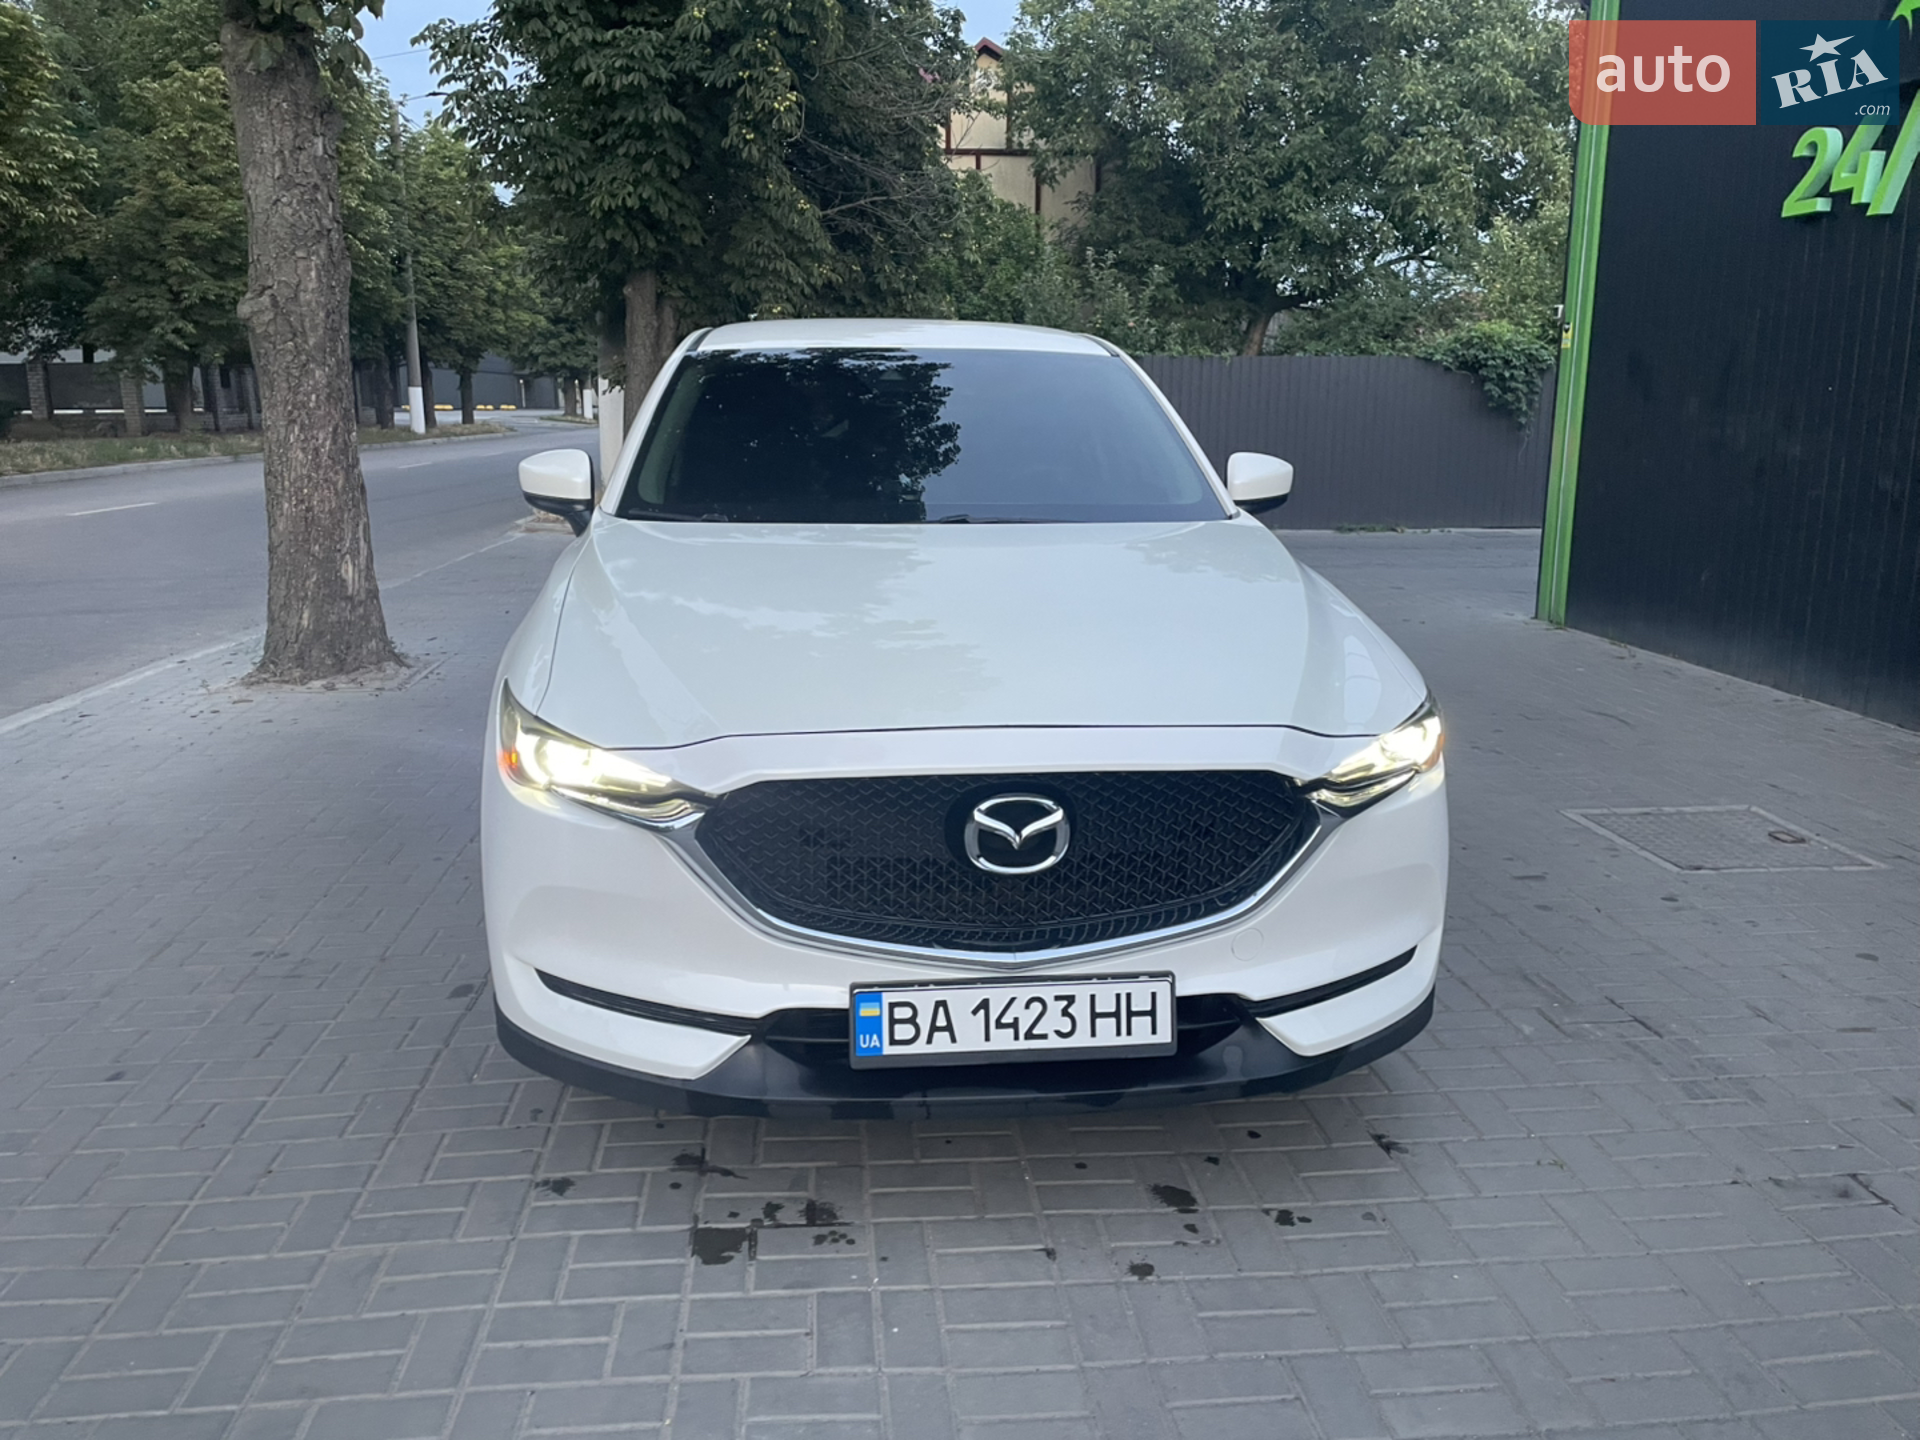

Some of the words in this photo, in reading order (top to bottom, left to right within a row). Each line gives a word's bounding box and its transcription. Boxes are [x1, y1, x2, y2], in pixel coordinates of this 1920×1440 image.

[888, 999, 957, 1046] BA
[970, 994, 1077, 1040] 1423
[1089, 991, 1157, 1037] HH
[859, 1034, 880, 1049] UA
